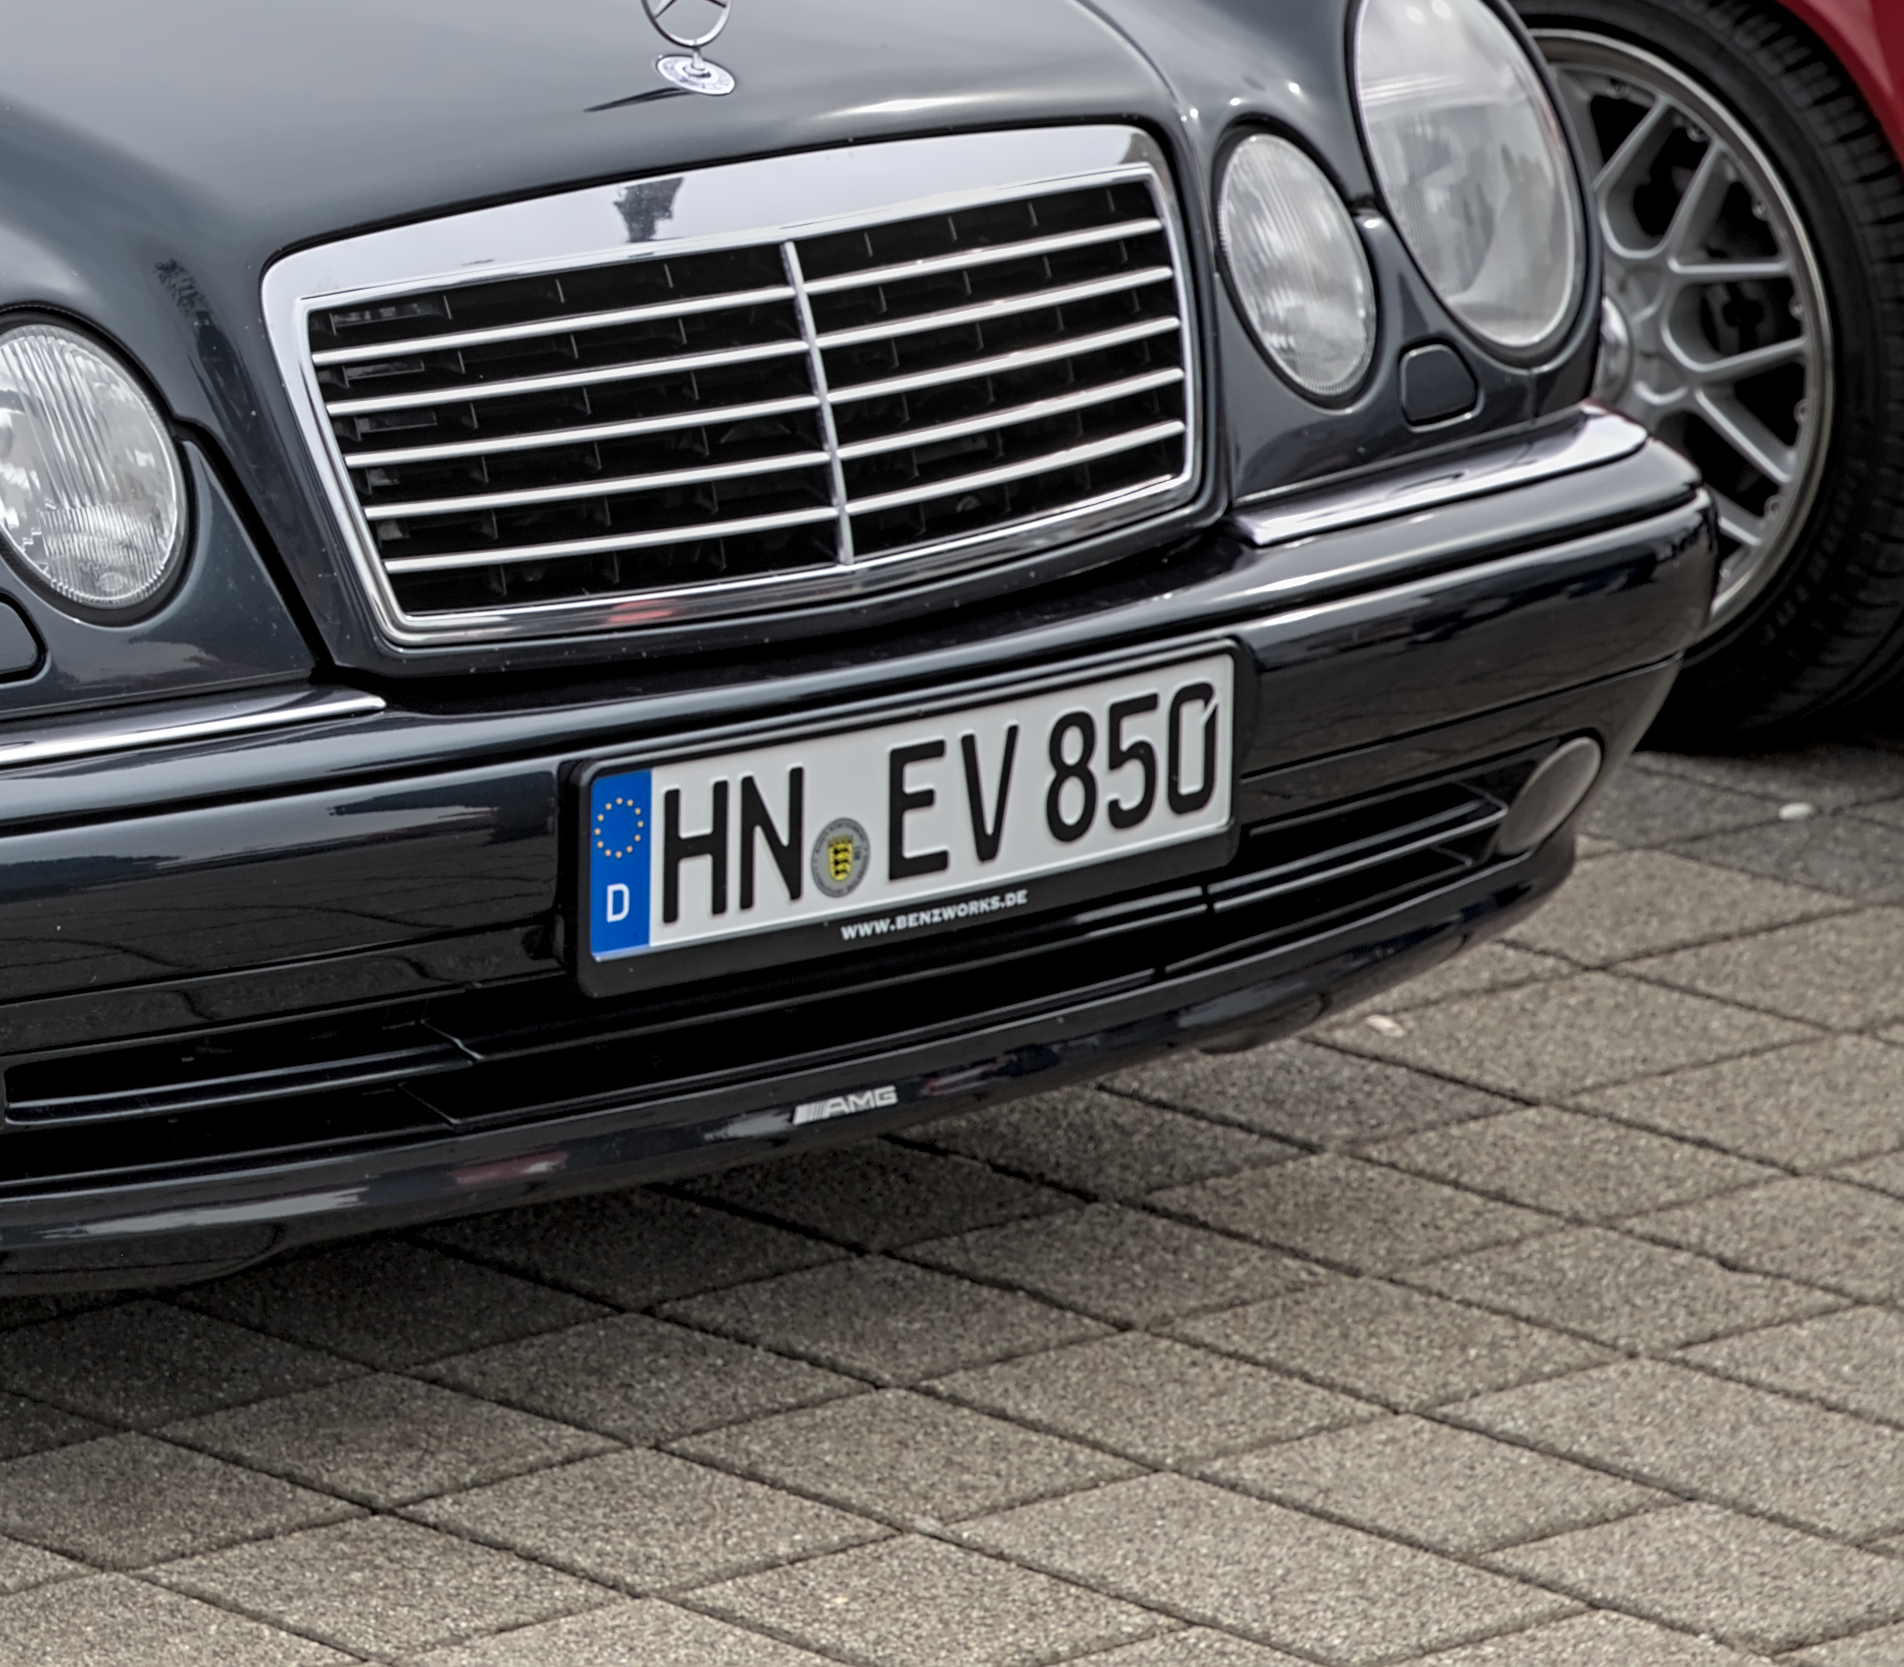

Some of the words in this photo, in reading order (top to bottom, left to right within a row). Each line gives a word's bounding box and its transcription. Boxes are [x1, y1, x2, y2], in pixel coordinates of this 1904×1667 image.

[663, 766, 805, 925] HN
[888, 724, 1021, 882] EV
[1044, 680, 1217, 844] 850
[606, 883, 631, 923] D
[840, 889, 1030, 941] WWW.BENZWORKS.DE
[822, 1085, 899, 1119] AMG
